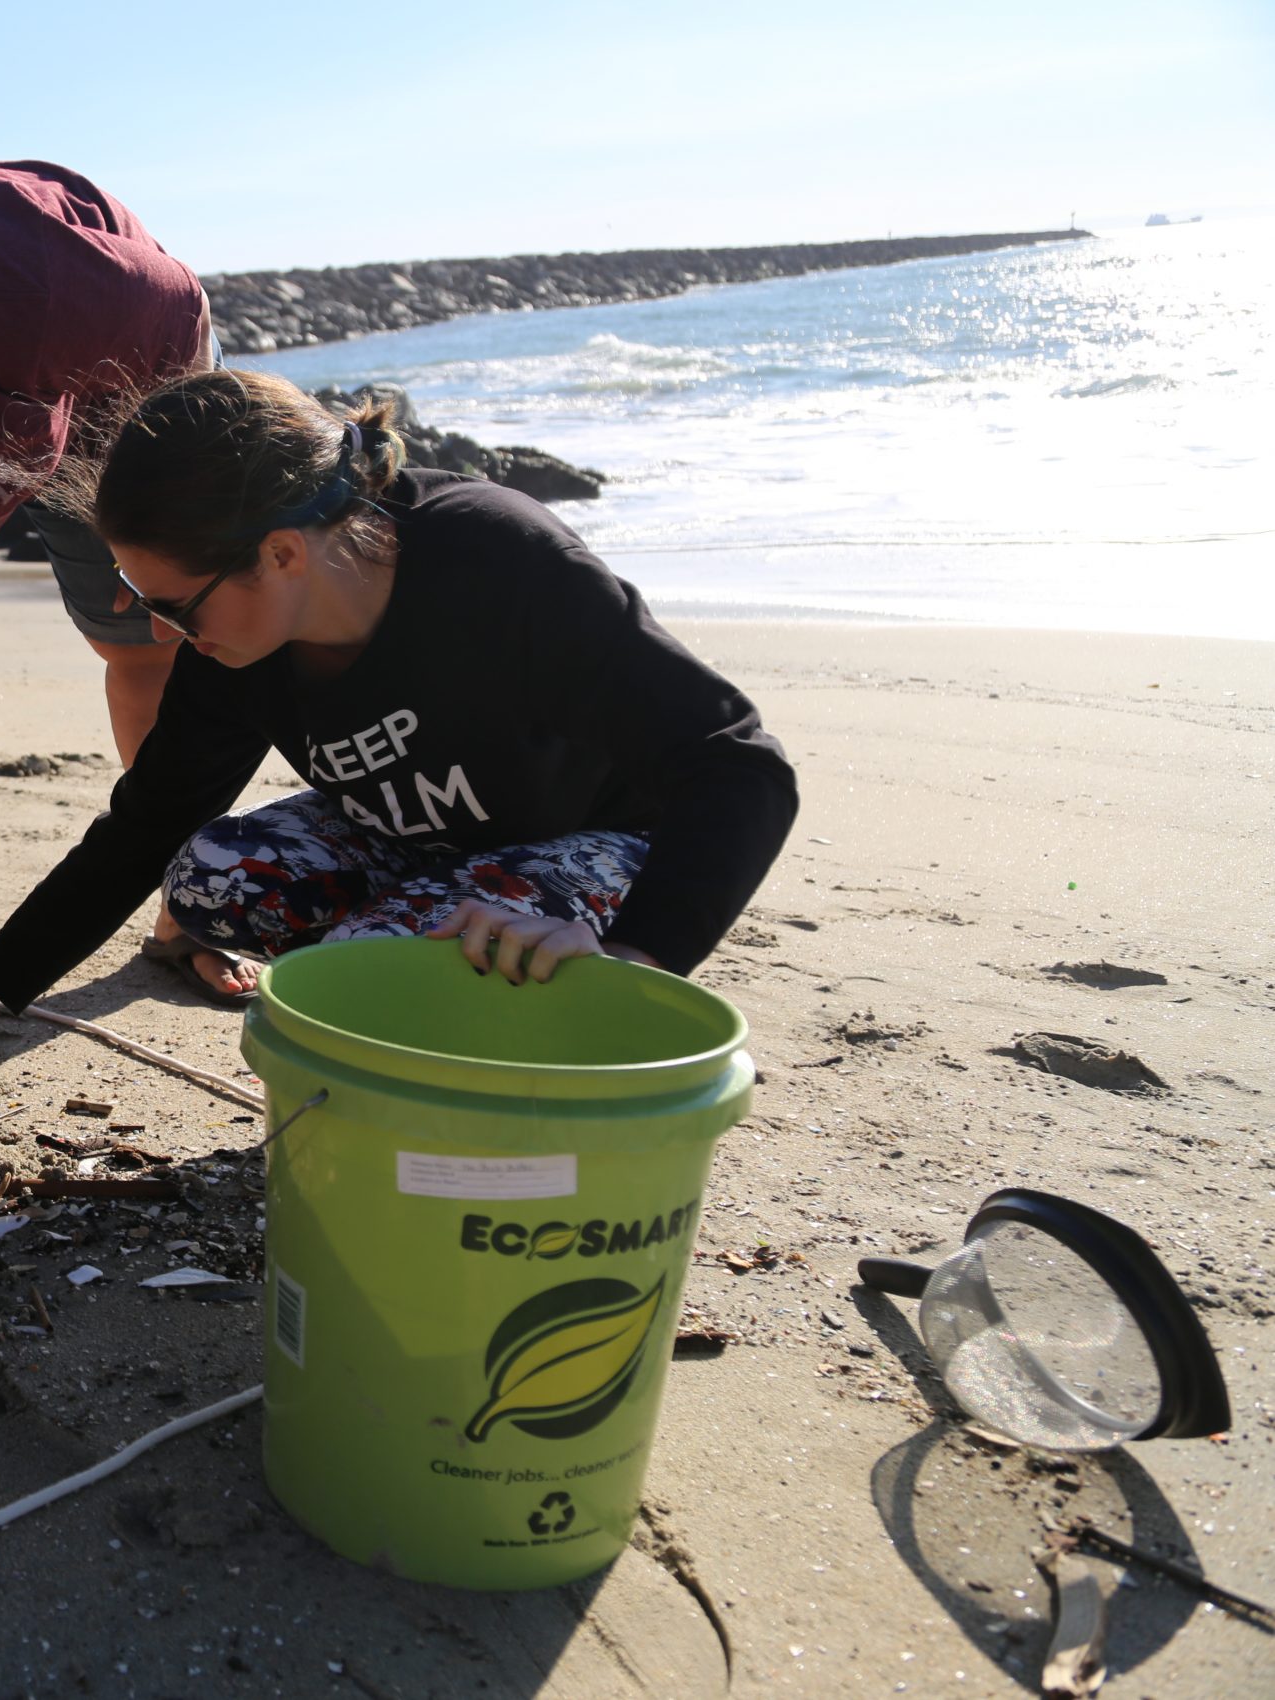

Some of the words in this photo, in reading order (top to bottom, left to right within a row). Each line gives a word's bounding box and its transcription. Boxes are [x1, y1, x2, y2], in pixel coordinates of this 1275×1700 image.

[306, 709, 418, 782] KEEP
[342, 764, 491, 837] ALM
[430, 1460, 503, 1482] Cleaner
[505, 1468, 561, 1485] jobs...
[564, 1457, 616, 1480] cleaner
